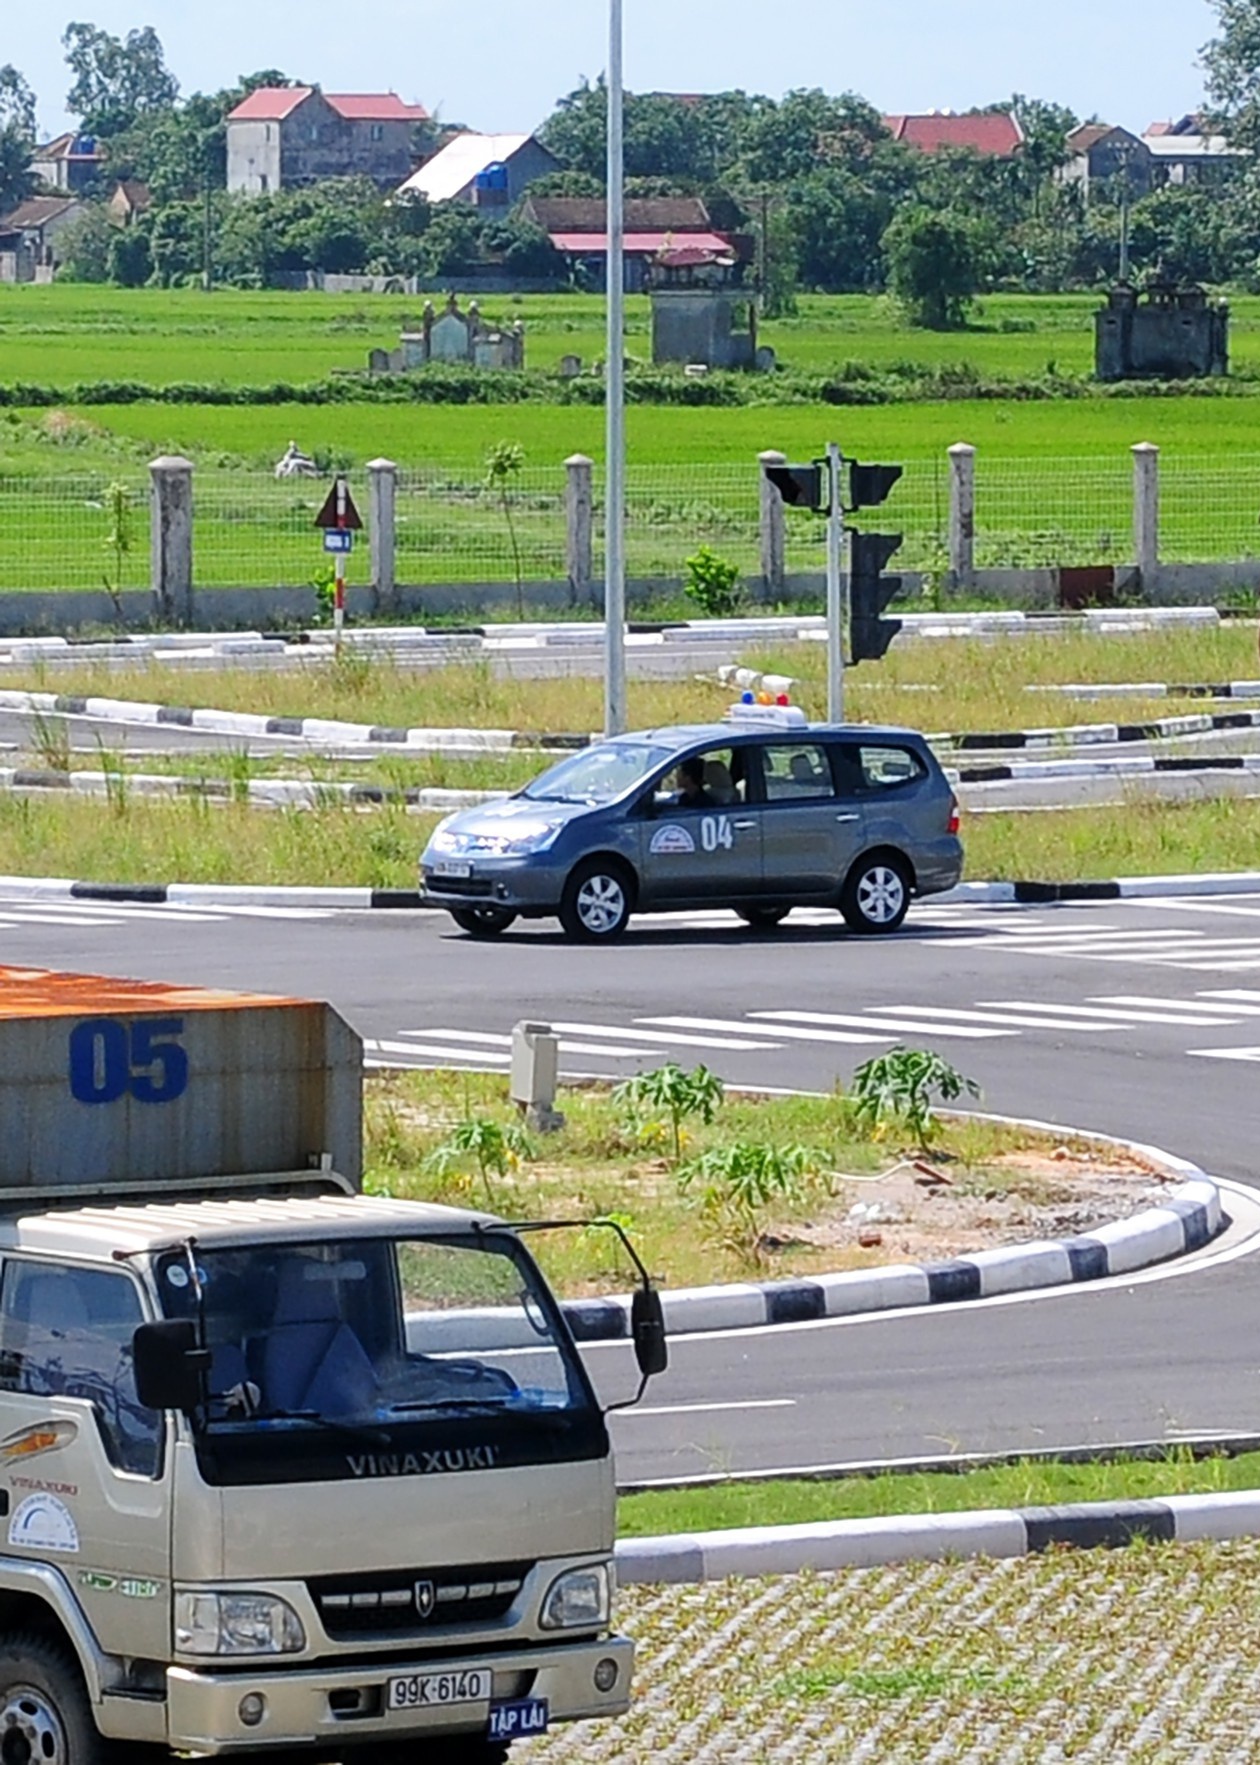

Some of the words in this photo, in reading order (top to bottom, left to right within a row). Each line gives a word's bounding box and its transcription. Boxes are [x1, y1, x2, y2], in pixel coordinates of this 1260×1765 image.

[701, 815, 733, 851] 04
[69, 1018, 189, 1104] 05
[346, 1445, 496, 1476] VINAXUKI
[9, 1475, 78, 1496] VINAXUKI
